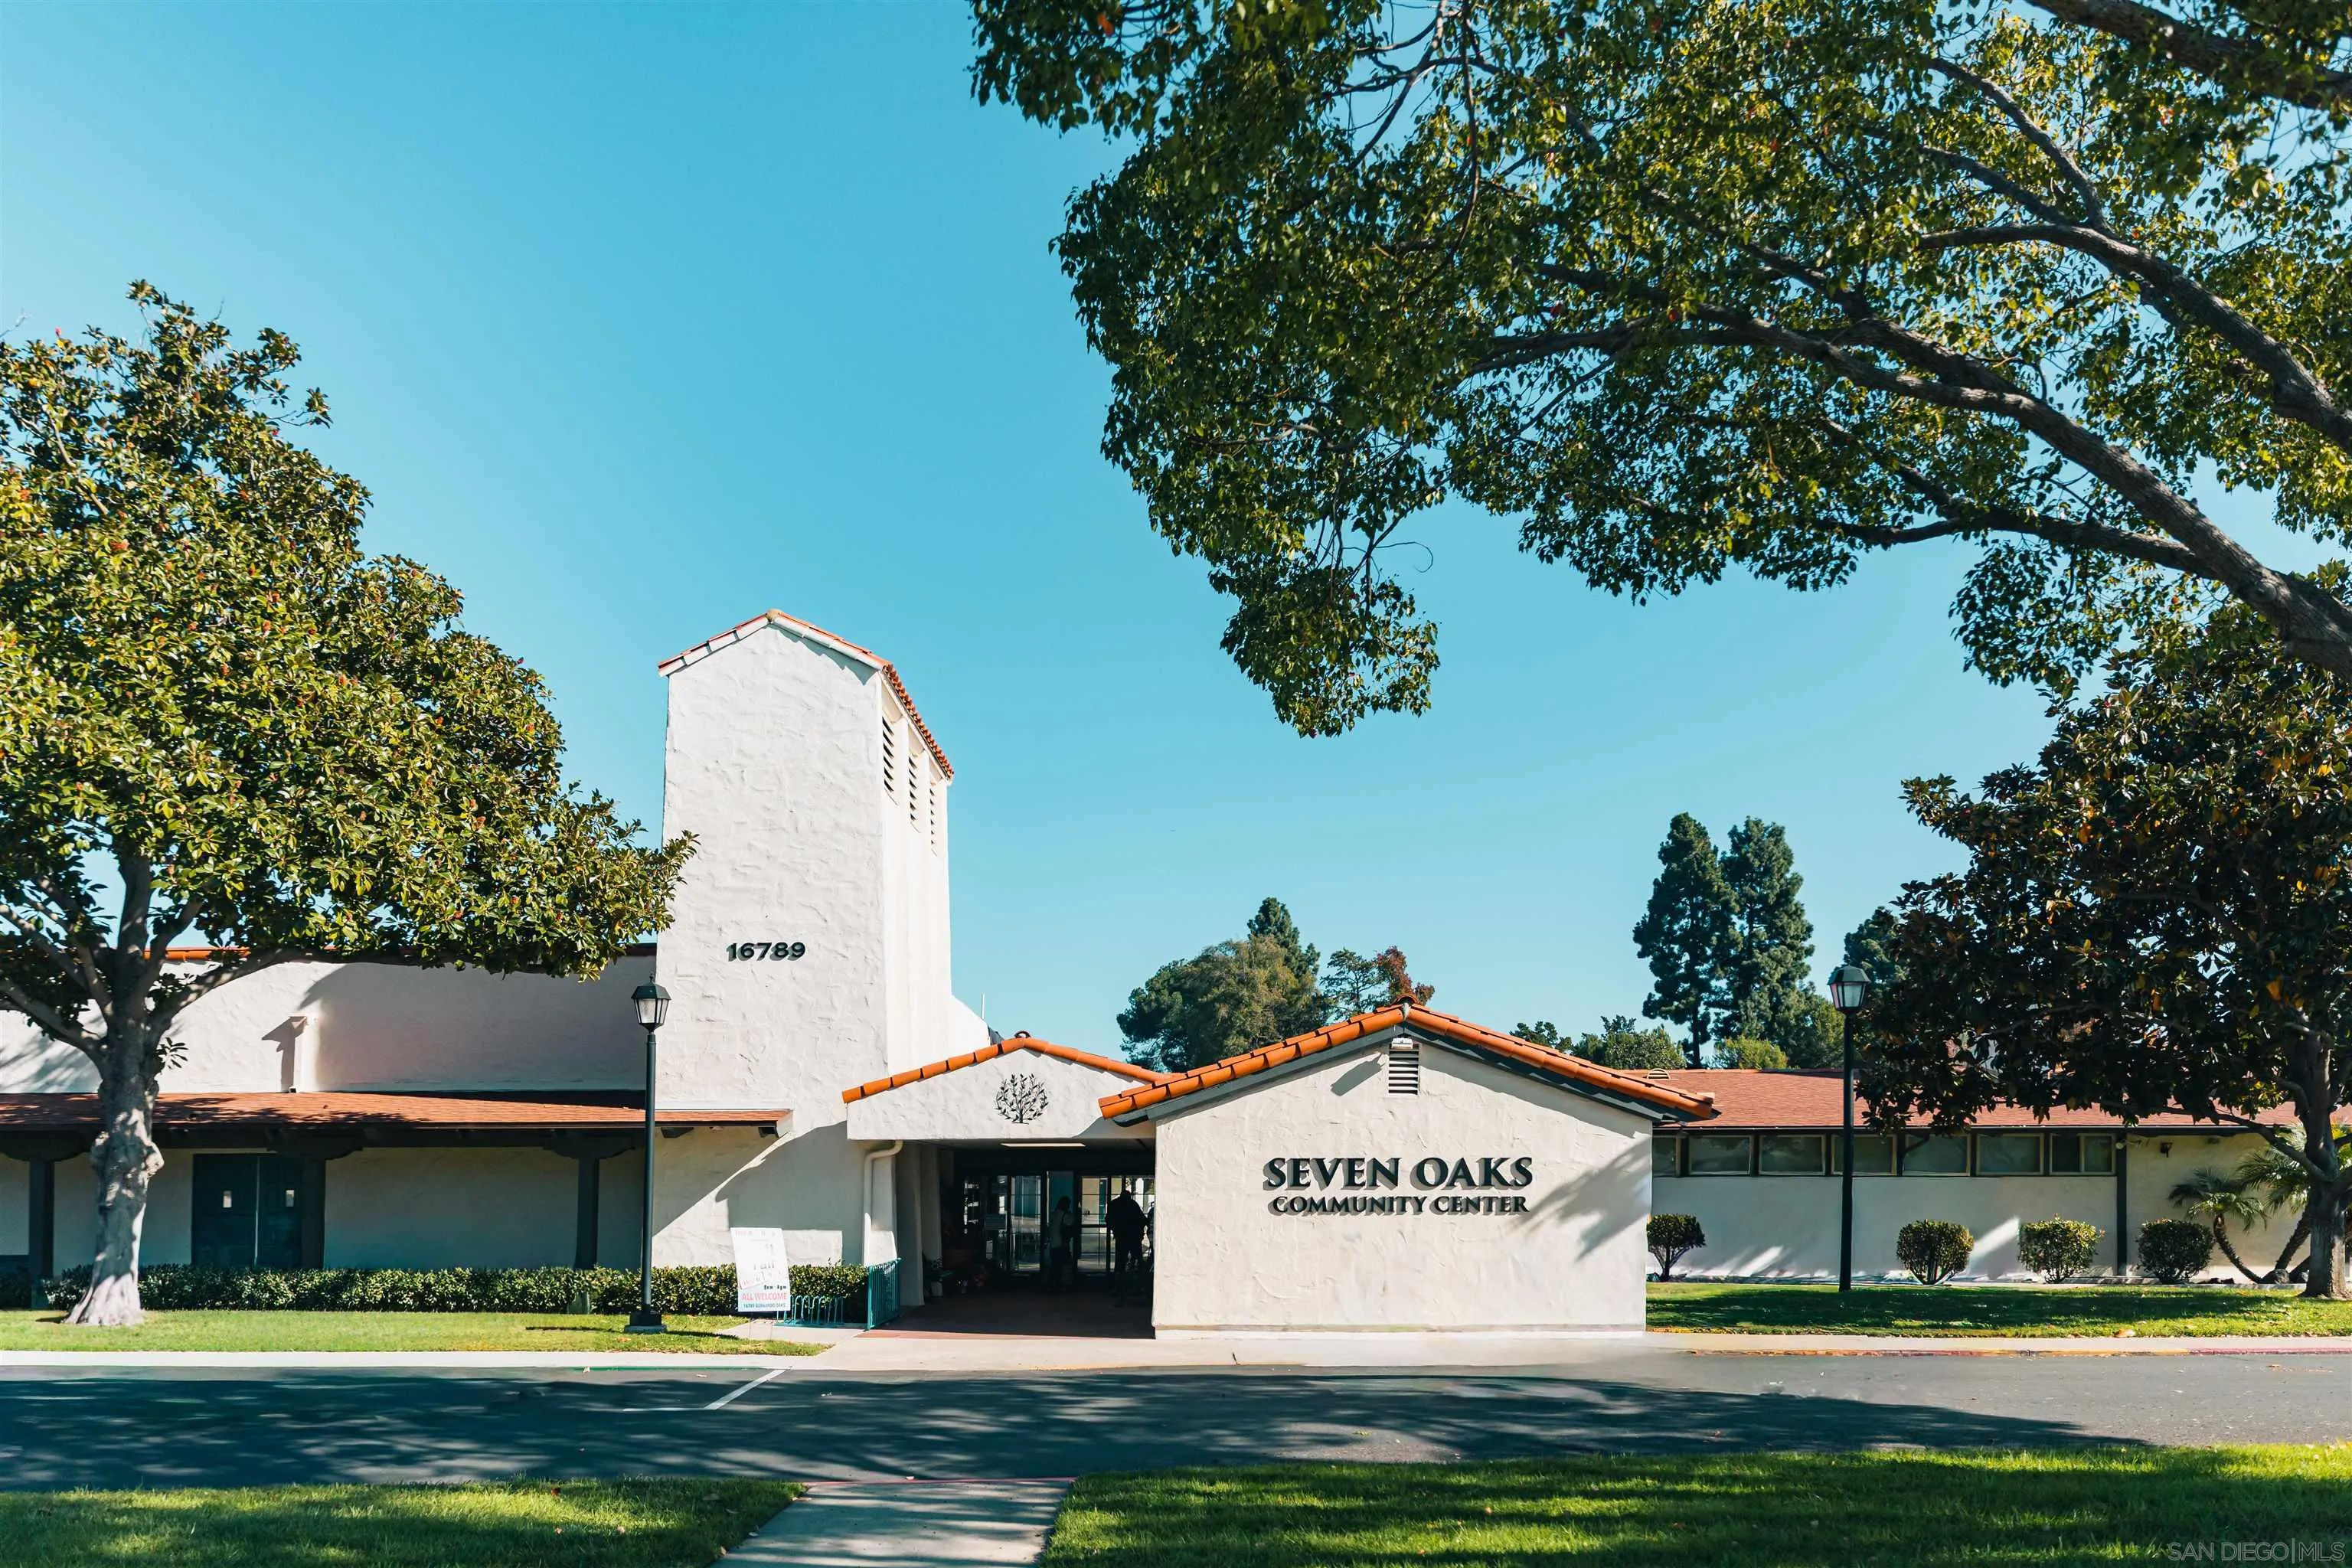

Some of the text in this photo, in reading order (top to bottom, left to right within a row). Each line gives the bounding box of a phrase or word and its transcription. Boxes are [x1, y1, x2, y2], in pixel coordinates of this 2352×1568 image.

[727, 942, 805, 960] 16789
[1265, 1158, 1533, 1188] SEVEN OAKS
[1270, 1196, 1530, 1214] COMMUNITY CENTER
[742, 1292, 754, 1301] ALL
